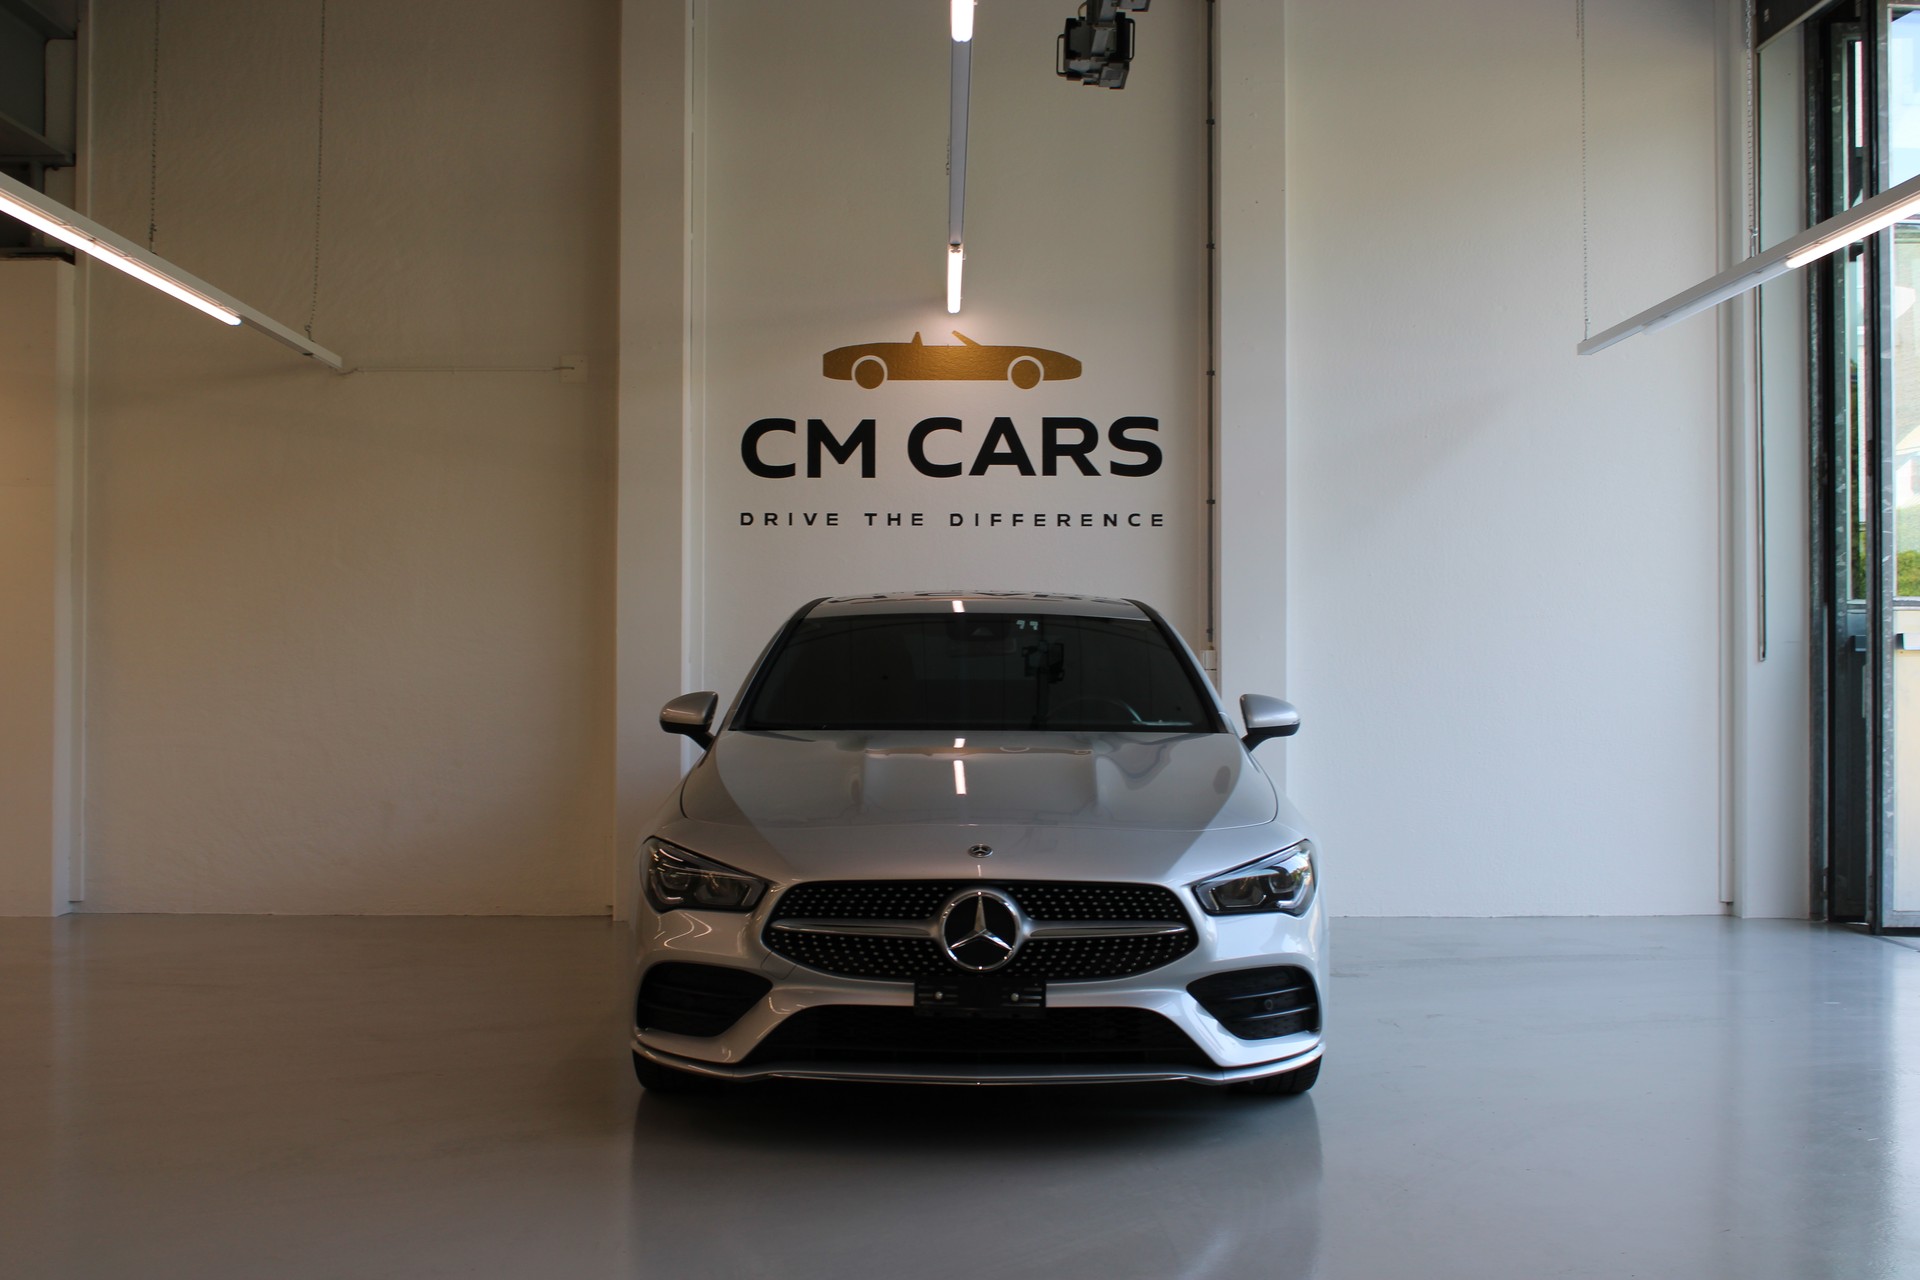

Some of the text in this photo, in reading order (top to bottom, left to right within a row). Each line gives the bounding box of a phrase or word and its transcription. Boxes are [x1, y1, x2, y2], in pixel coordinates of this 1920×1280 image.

[741, 416, 1163, 479] CM CARS
[740, 512, 1164, 527] DRIVE THE DIFFERENCE
